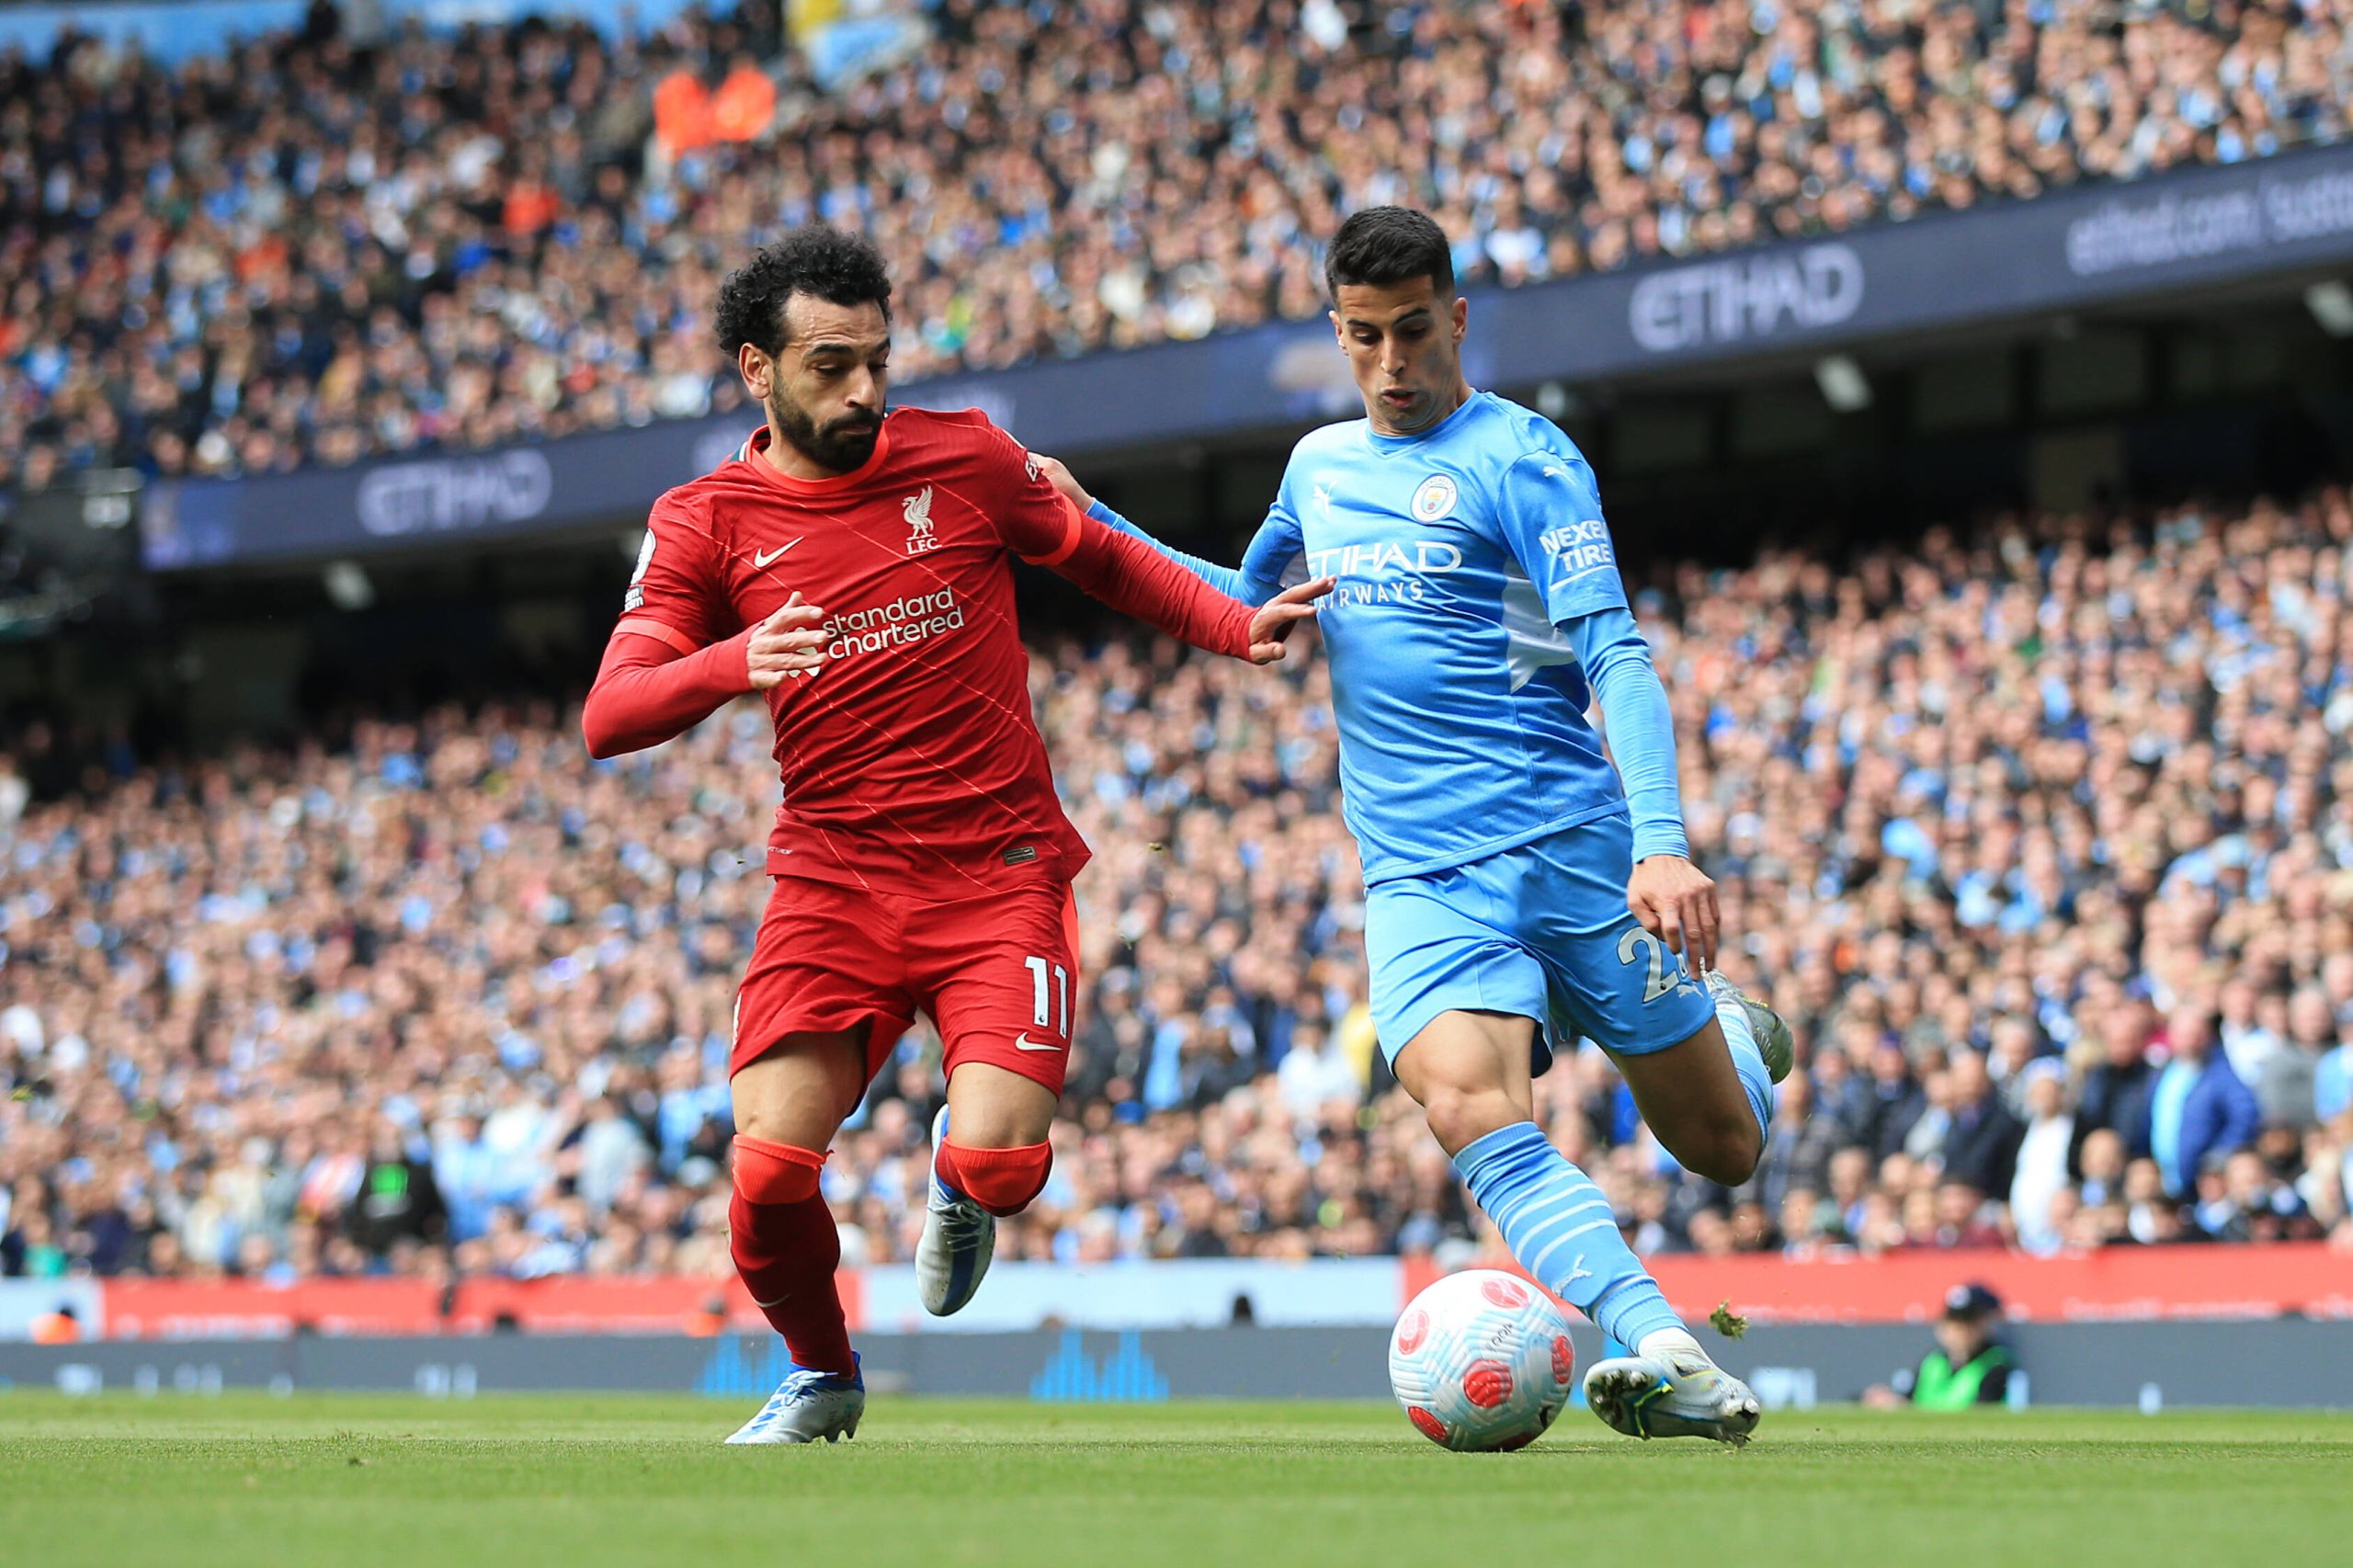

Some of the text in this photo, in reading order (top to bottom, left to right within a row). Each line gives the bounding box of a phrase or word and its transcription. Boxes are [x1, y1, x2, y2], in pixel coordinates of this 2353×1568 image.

[1631, 243, 1863, 351] ETIHAD
[358, 449, 551, 536] ETIHAD
[1559, 543, 1612, 572] TIRE
[823, 585, 954, 638] standard
[1318, 580, 1424, 612] AIRWAYS
[828, 606, 964, 659] chartered
[1618, 926, 1688, 1003] 2
[1025, 956, 1066, 1040] 11
